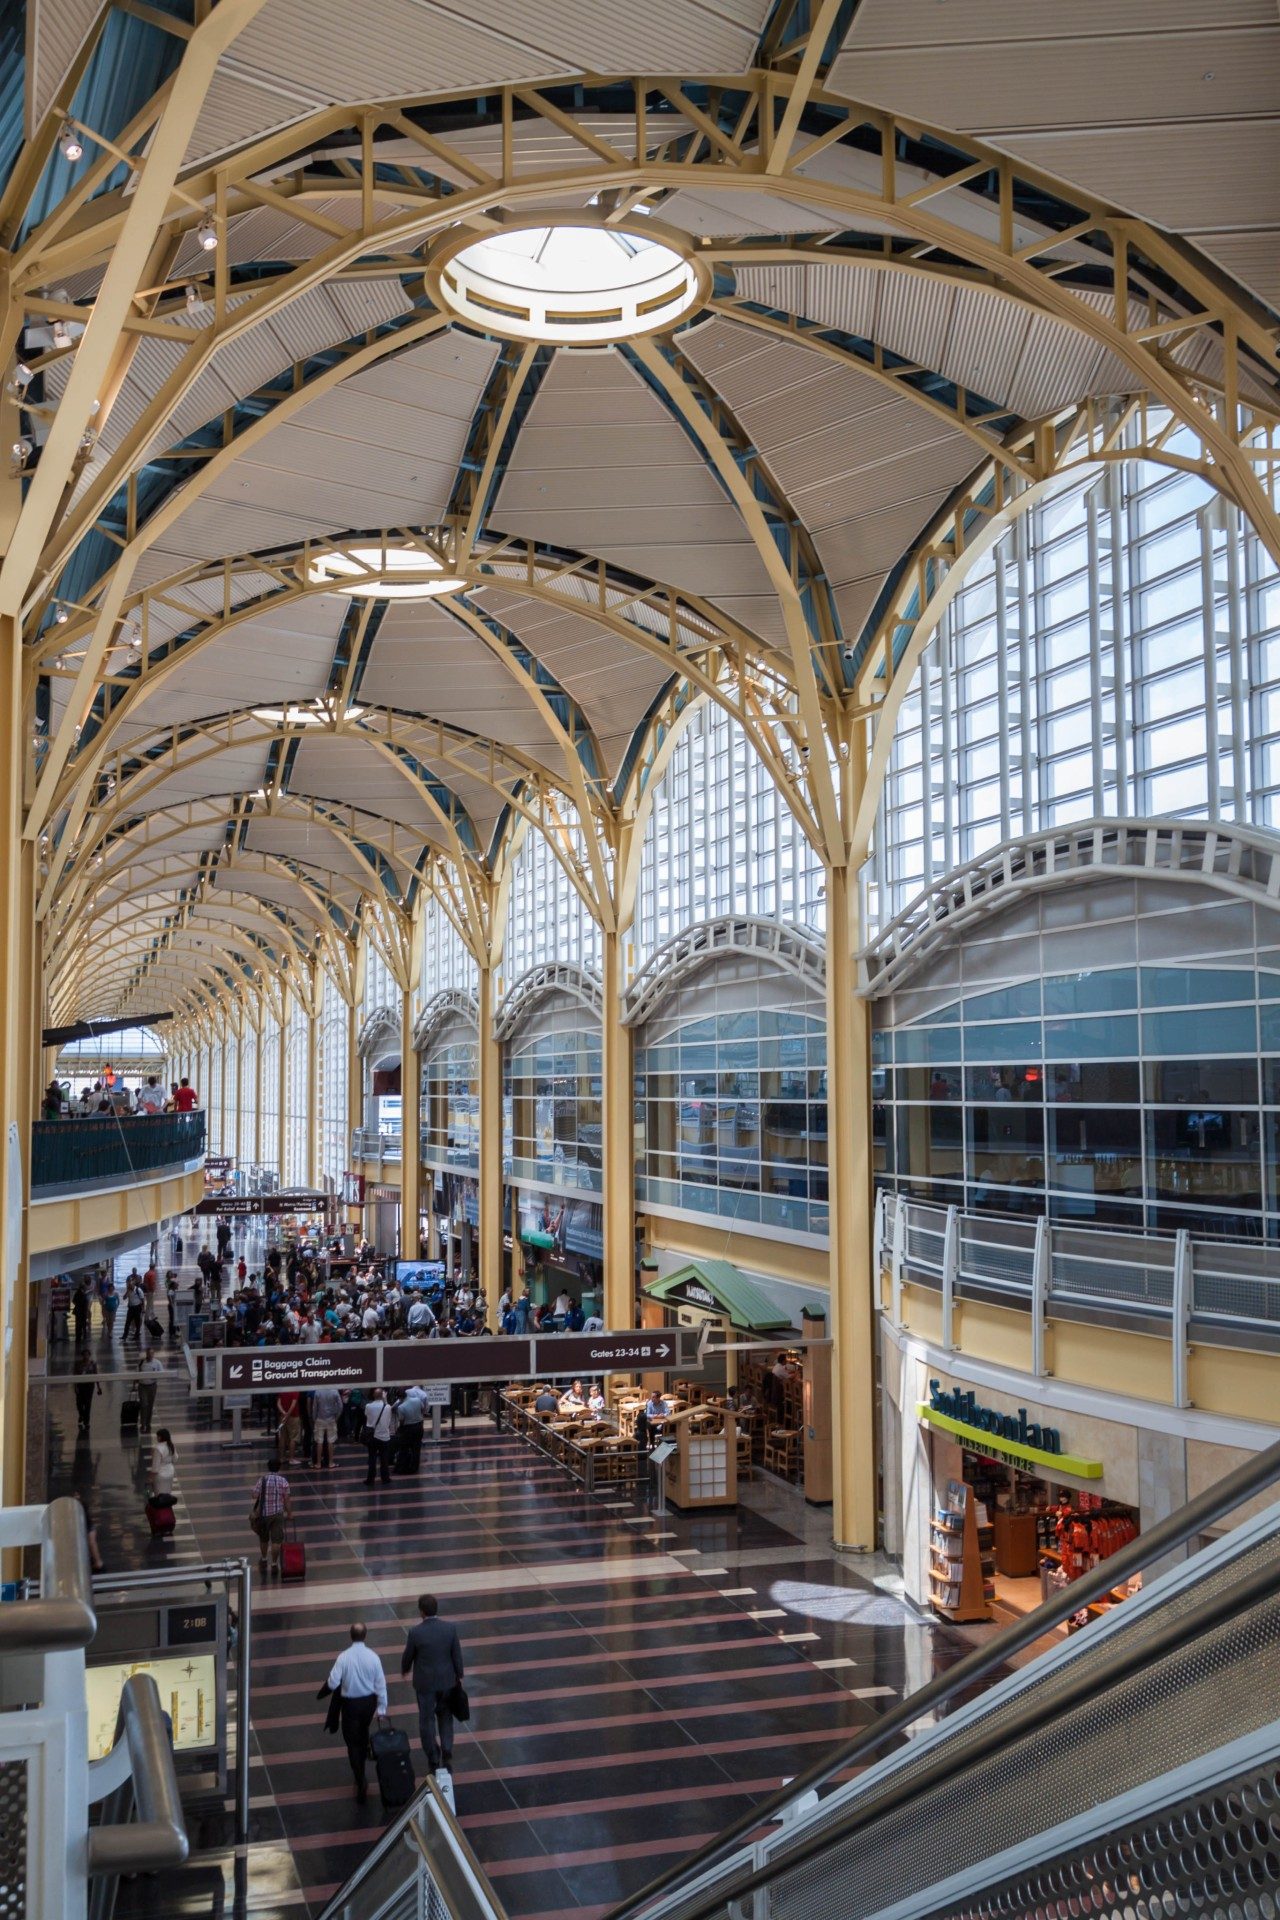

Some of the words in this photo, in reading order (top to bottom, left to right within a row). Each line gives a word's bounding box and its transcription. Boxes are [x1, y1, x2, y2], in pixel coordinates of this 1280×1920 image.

[590, 1349, 614, 1358] Gates
[615, 1348, 639, 1357] 23-34
[264, 1359, 303, 1370] Baggage
[305, 1357, 331, 1366] Claim
[264, 1370, 299, 1380] Ground
[300, 1367, 363, 1379] Transportation
[1000, 1452, 1034, 1474] STORE
